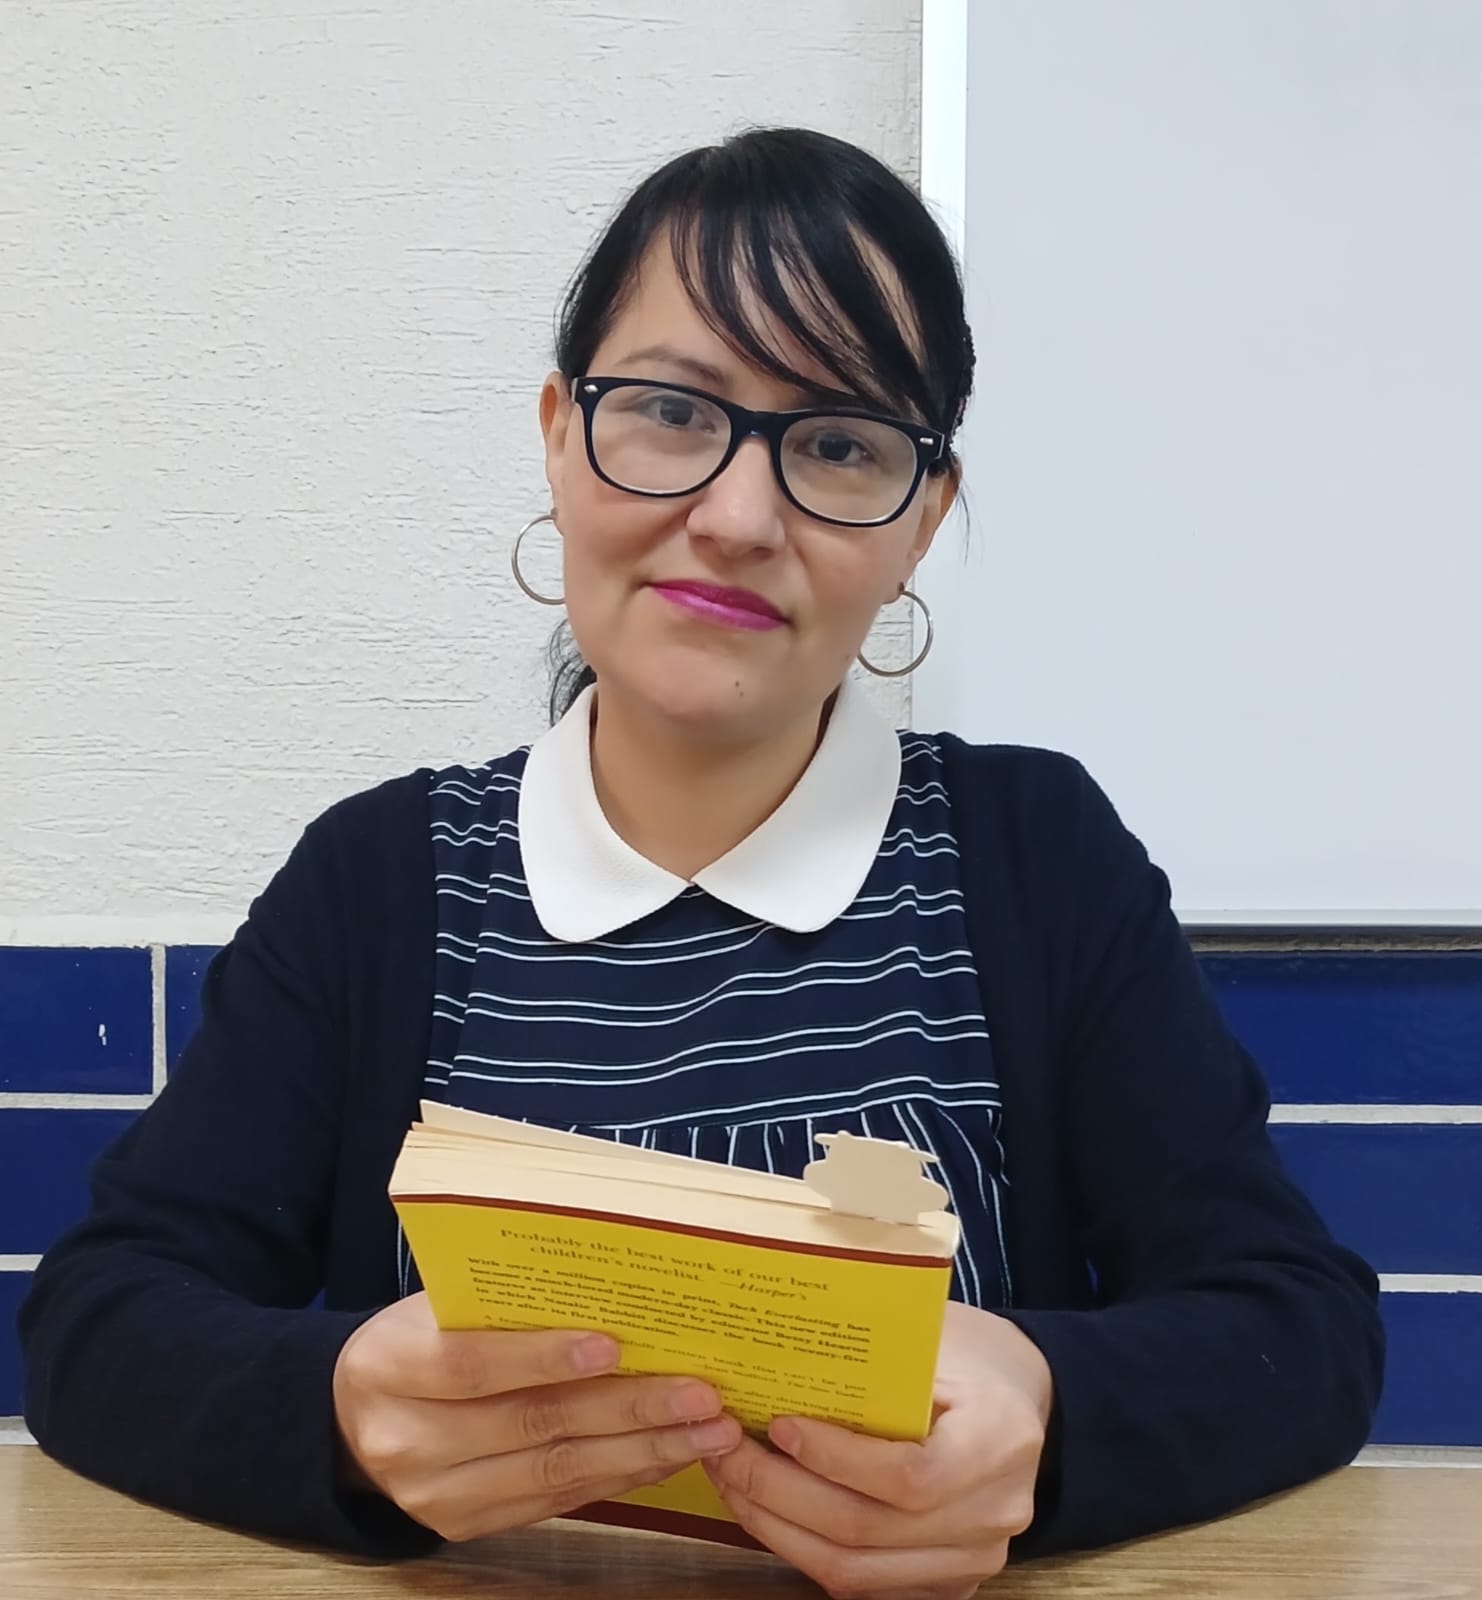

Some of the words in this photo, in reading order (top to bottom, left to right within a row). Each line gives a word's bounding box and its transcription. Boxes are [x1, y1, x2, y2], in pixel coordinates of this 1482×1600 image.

[500, 1228, 581, 1248] Probably
[589, 1241, 619, 1253] the
[626, 1247, 663, 1261] best
[670, 1257, 715, 1271] work
[723, 1266, 742, 1276] of
[748, 1272, 782, 1283] our
[790, 1276, 828, 1291] best
[530, 1245, 622, 1266] children's
[629, 1261, 703, 1282] novelist.
[468, 1256, 499, 1267] With
[506, 1262, 534, 1271] over
[556, 1270, 605, 1283] million
[612, 1279, 654, 1292] copies
[728, 1301, 757, 1312] Tuck
[764, 1308, 840, 1329] Everlasting
[846, 1323, 870, 1332] has
[470, 1266, 520, 1279] become
[535, 1276, 613, 1294] much-loved
[617, 1290, 697, 1311] modern-day
[701, 1306, 749, 1321] classic.
[755, 1317, 785, 1328] This
[789, 1325, 815, 1333] new
[819, 1330, 870, 1343] edition
[473, 1276, 525, 1289] features
[551, 1288, 610, 1303] interview
[616, 1300, 685, 1318] conducted
[690, 1314, 705, 1323] by
[711, 1318, 768, 1335] educator
[775, 1331, 811, 1345] Betsy
[817, 1339, 868, 1353] Hearne
[479, 1296, 512, 1306] years
[517, 1302, 545, 1311] after
[571, 1310, 597, 1320] first
[602, 1316, 678, 1336] publication.
[497, 1289, 535, 1300] which
[544, 1297, 590, 1309] Natalie
[599, 1306, 646, 1320] Babbitt
[654, 1316, 716, 1334] discusses
[723, 1331, 744, 1340] the
[752, 1336, 784, 1348] book
[792, 1344, 867, 1363] twenty-five
[713, 1355, 744, 1367] book
[751, 1363, 776, 1374] that
[821, 1377, 836, 1386] be
[844, 1382, 866, 1392] put
